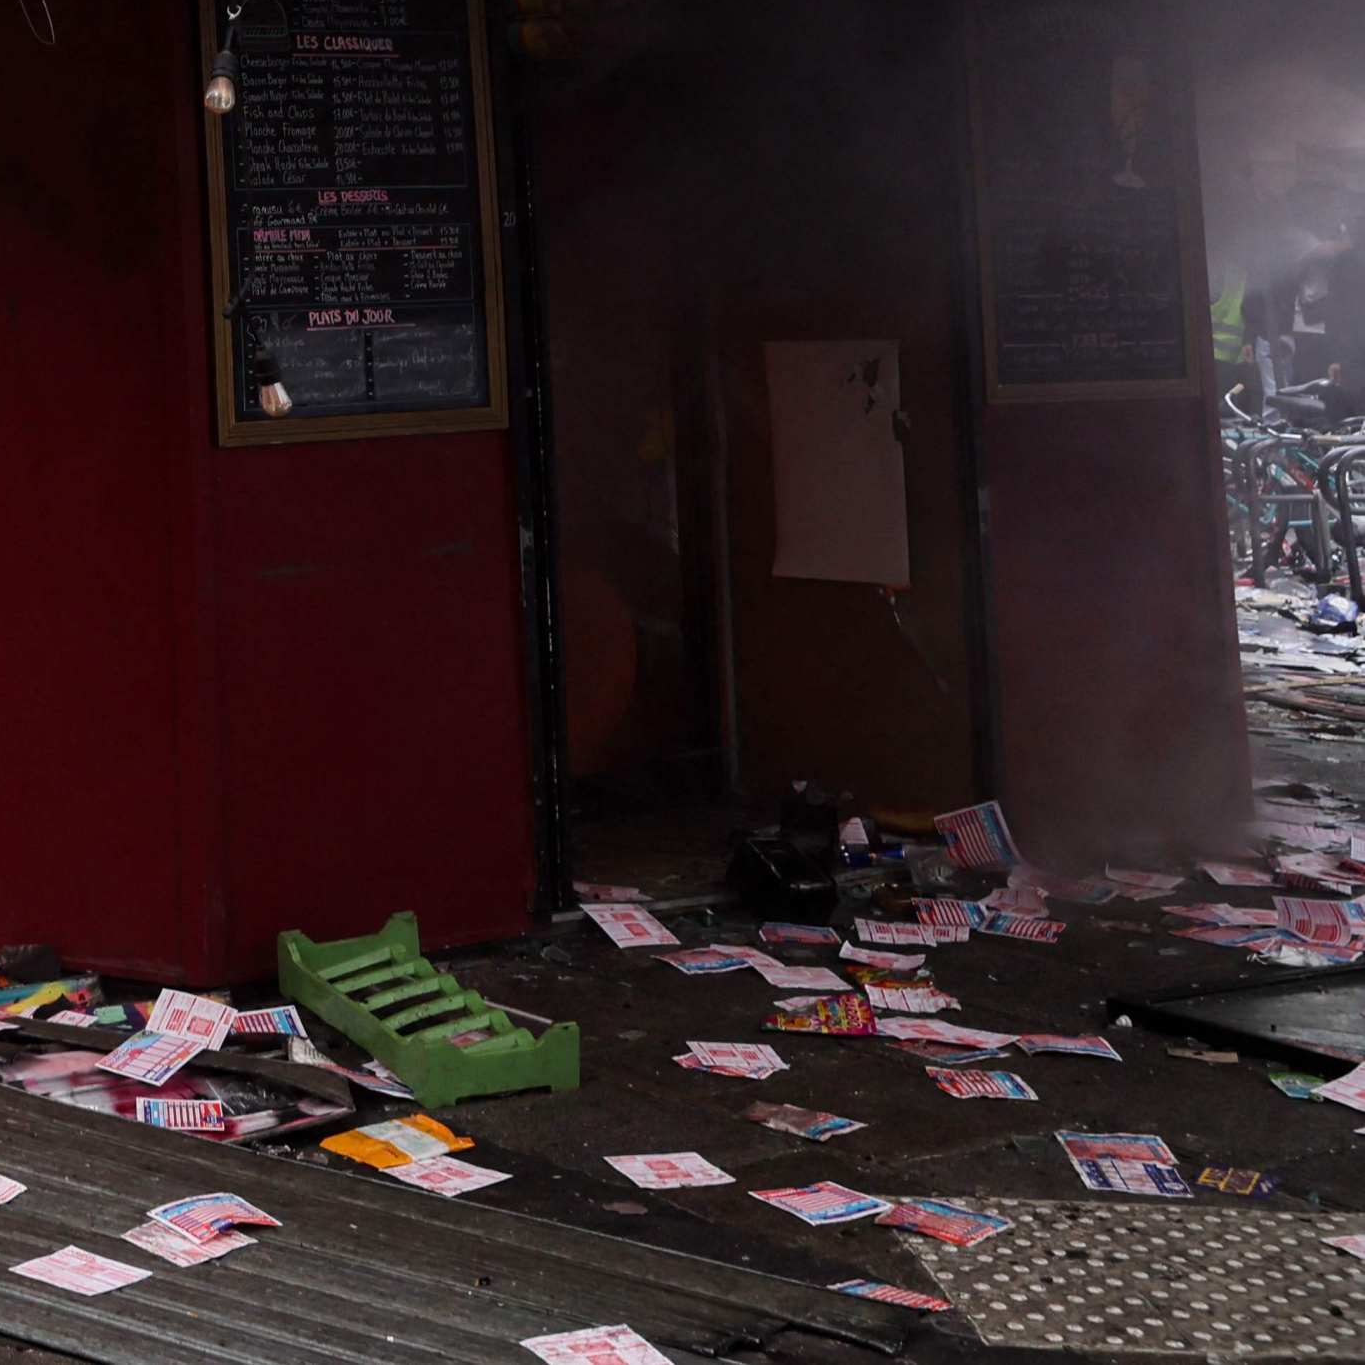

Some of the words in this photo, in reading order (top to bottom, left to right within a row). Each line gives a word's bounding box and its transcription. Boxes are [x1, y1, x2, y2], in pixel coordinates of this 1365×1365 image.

[297, 35, 318, 50] LES
[318, 189, 337, 205] LES
[308, 308, 342, 327] PLATS
[361, 308, 396, 325] JOUR
